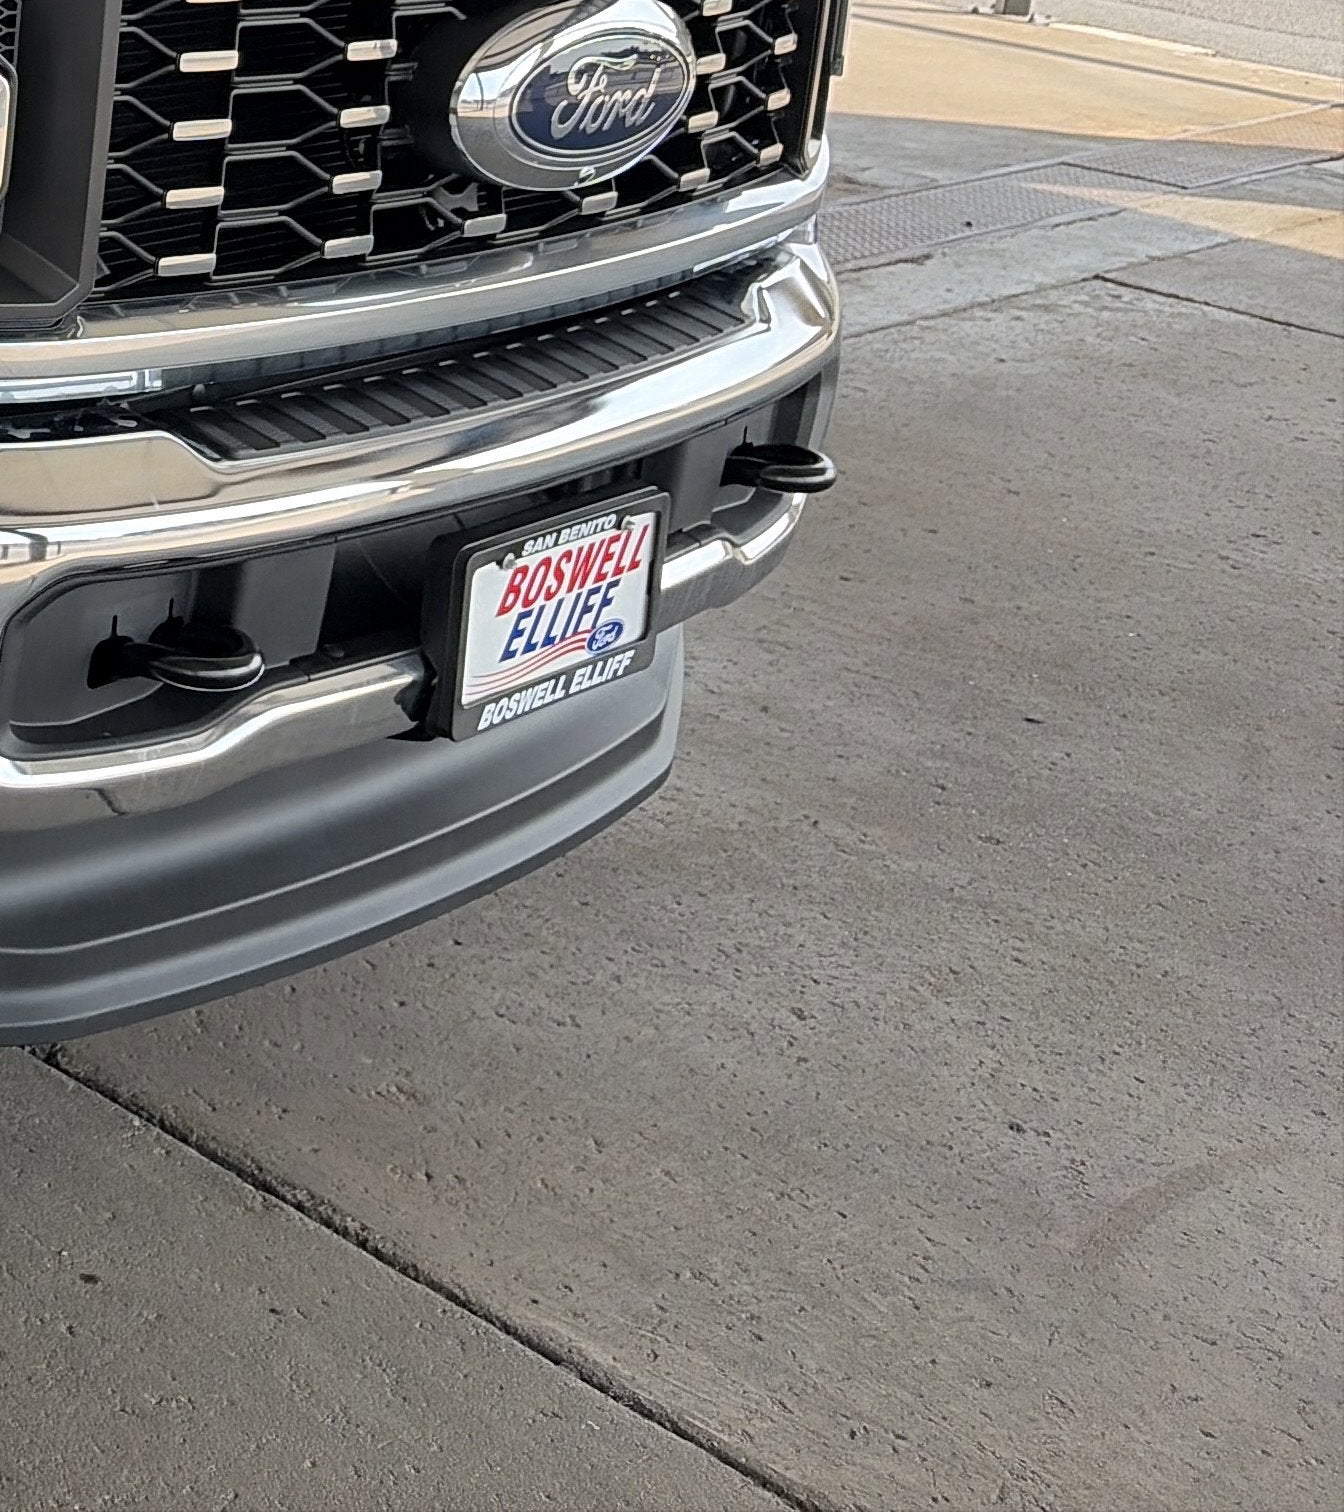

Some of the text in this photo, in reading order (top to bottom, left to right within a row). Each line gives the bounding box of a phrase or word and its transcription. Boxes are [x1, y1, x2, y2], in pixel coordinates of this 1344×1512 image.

[550, 53, 661, 140] Ford
[495, 524, 650, 618] BOSWELL
[521, 513, 618, 556] SAN BENITO
[498, 577, 622, 663] ELLIFF
[591, 624, 620, 650] Ford
[477, 649, 635, 731] BOSWELL ELLIFF
